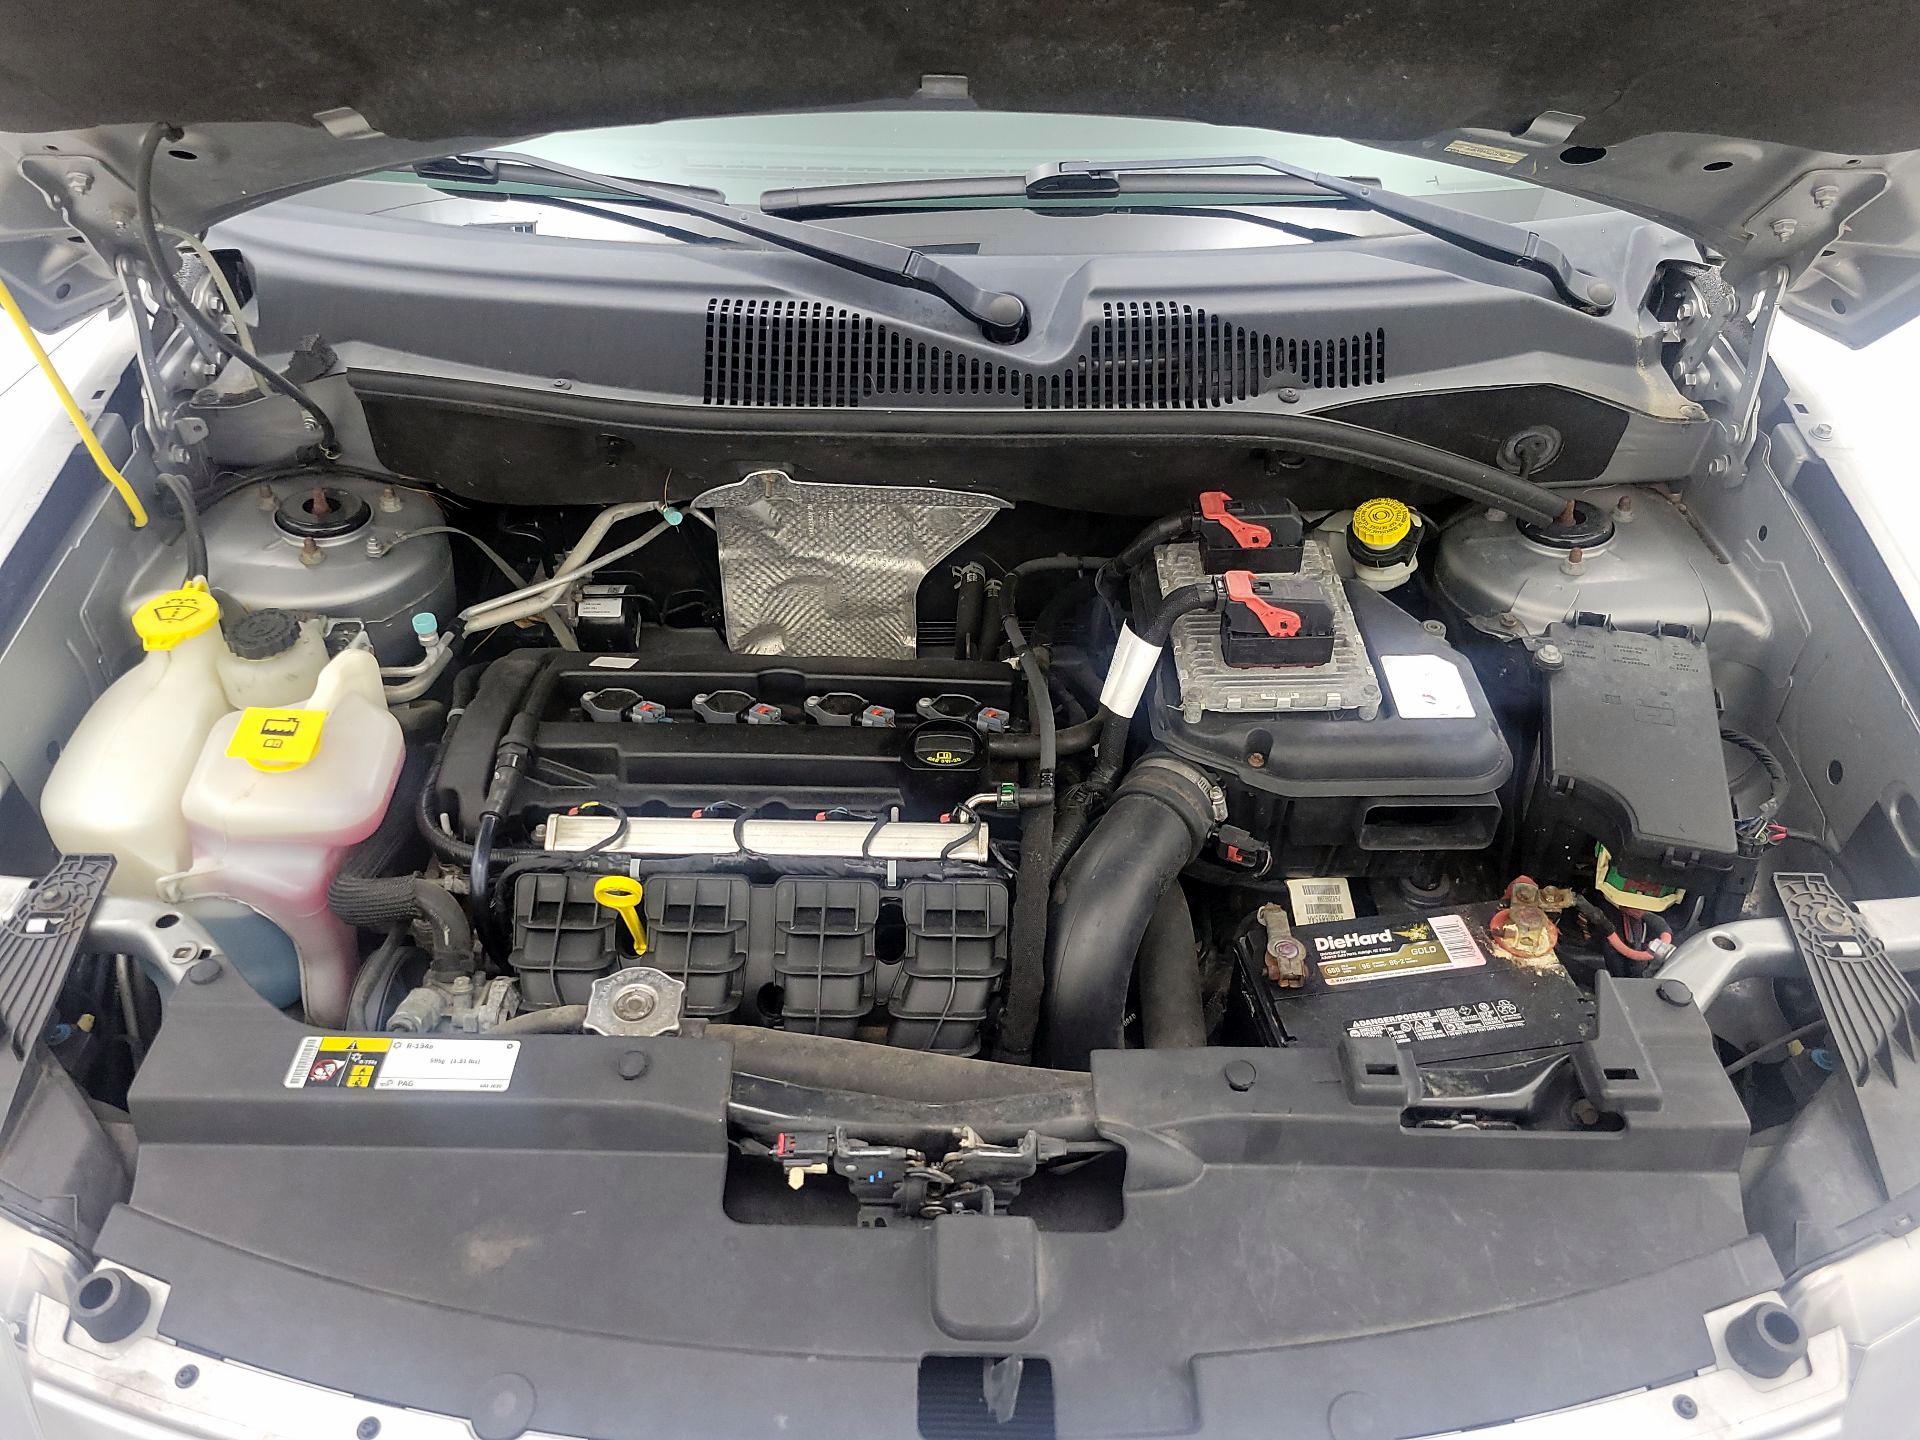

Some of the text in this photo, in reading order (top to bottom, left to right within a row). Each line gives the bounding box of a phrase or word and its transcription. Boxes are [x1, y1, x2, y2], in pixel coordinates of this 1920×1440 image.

[1314, 929, 1393, 952] DieHard
[1410, 945, 1437, 956] GOLD
[1359, 1010, 1431, 1027] DANGER/POISON
